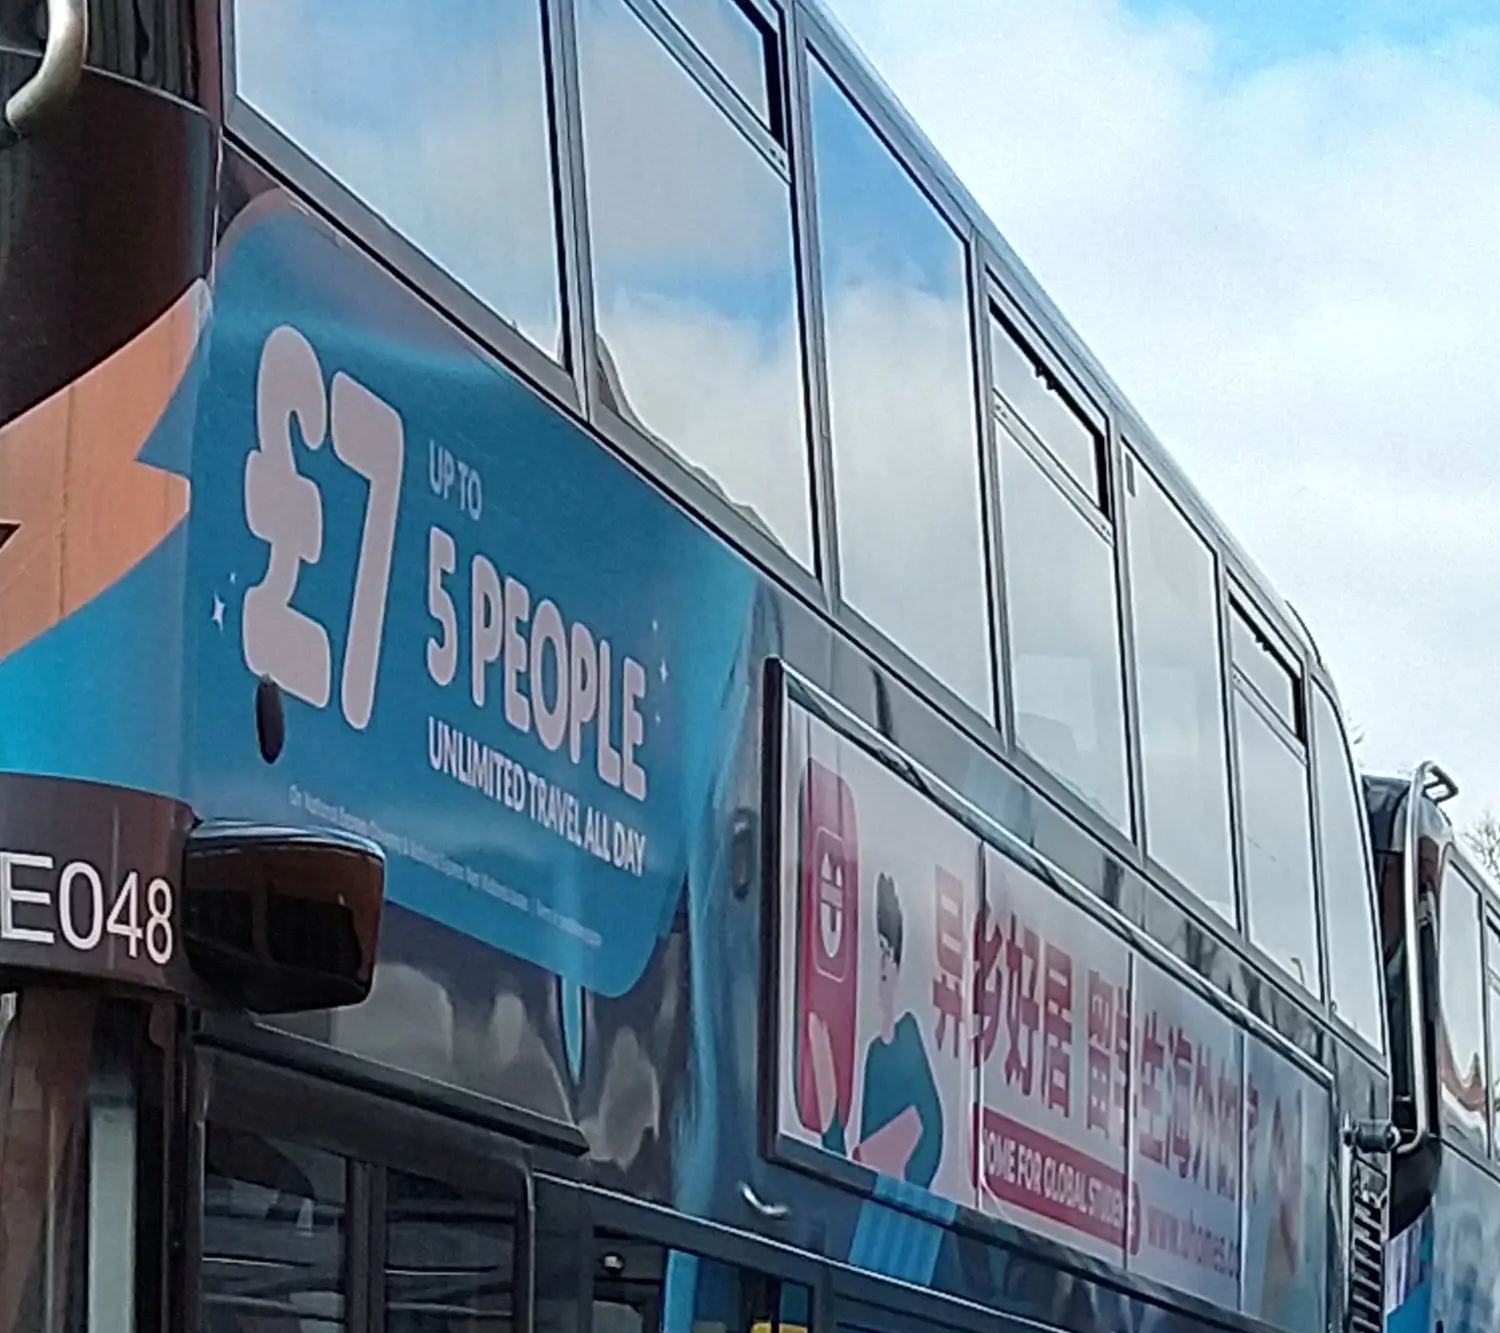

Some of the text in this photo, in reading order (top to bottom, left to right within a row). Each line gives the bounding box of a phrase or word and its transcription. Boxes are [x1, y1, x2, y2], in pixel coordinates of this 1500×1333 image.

[243, 325, 404, 729] £7
[428, 440, 482, 520] UP TO
[427, 526, 645, 800] 5 PEOPLE
[428, 717, 526, 812] UNLIMITED
[527, 772, 582, 846] TRAVEL
[583, 806, 611, 863] ALL
[613, 821, 646, 877] DAY
[0, 851, 173, 964] E048
[984, 1128, 1015, 1184] OME
[1017, 1143, 1042, 1196] FOR
[1043, 1155, 1087, 1214] GLOBAL
